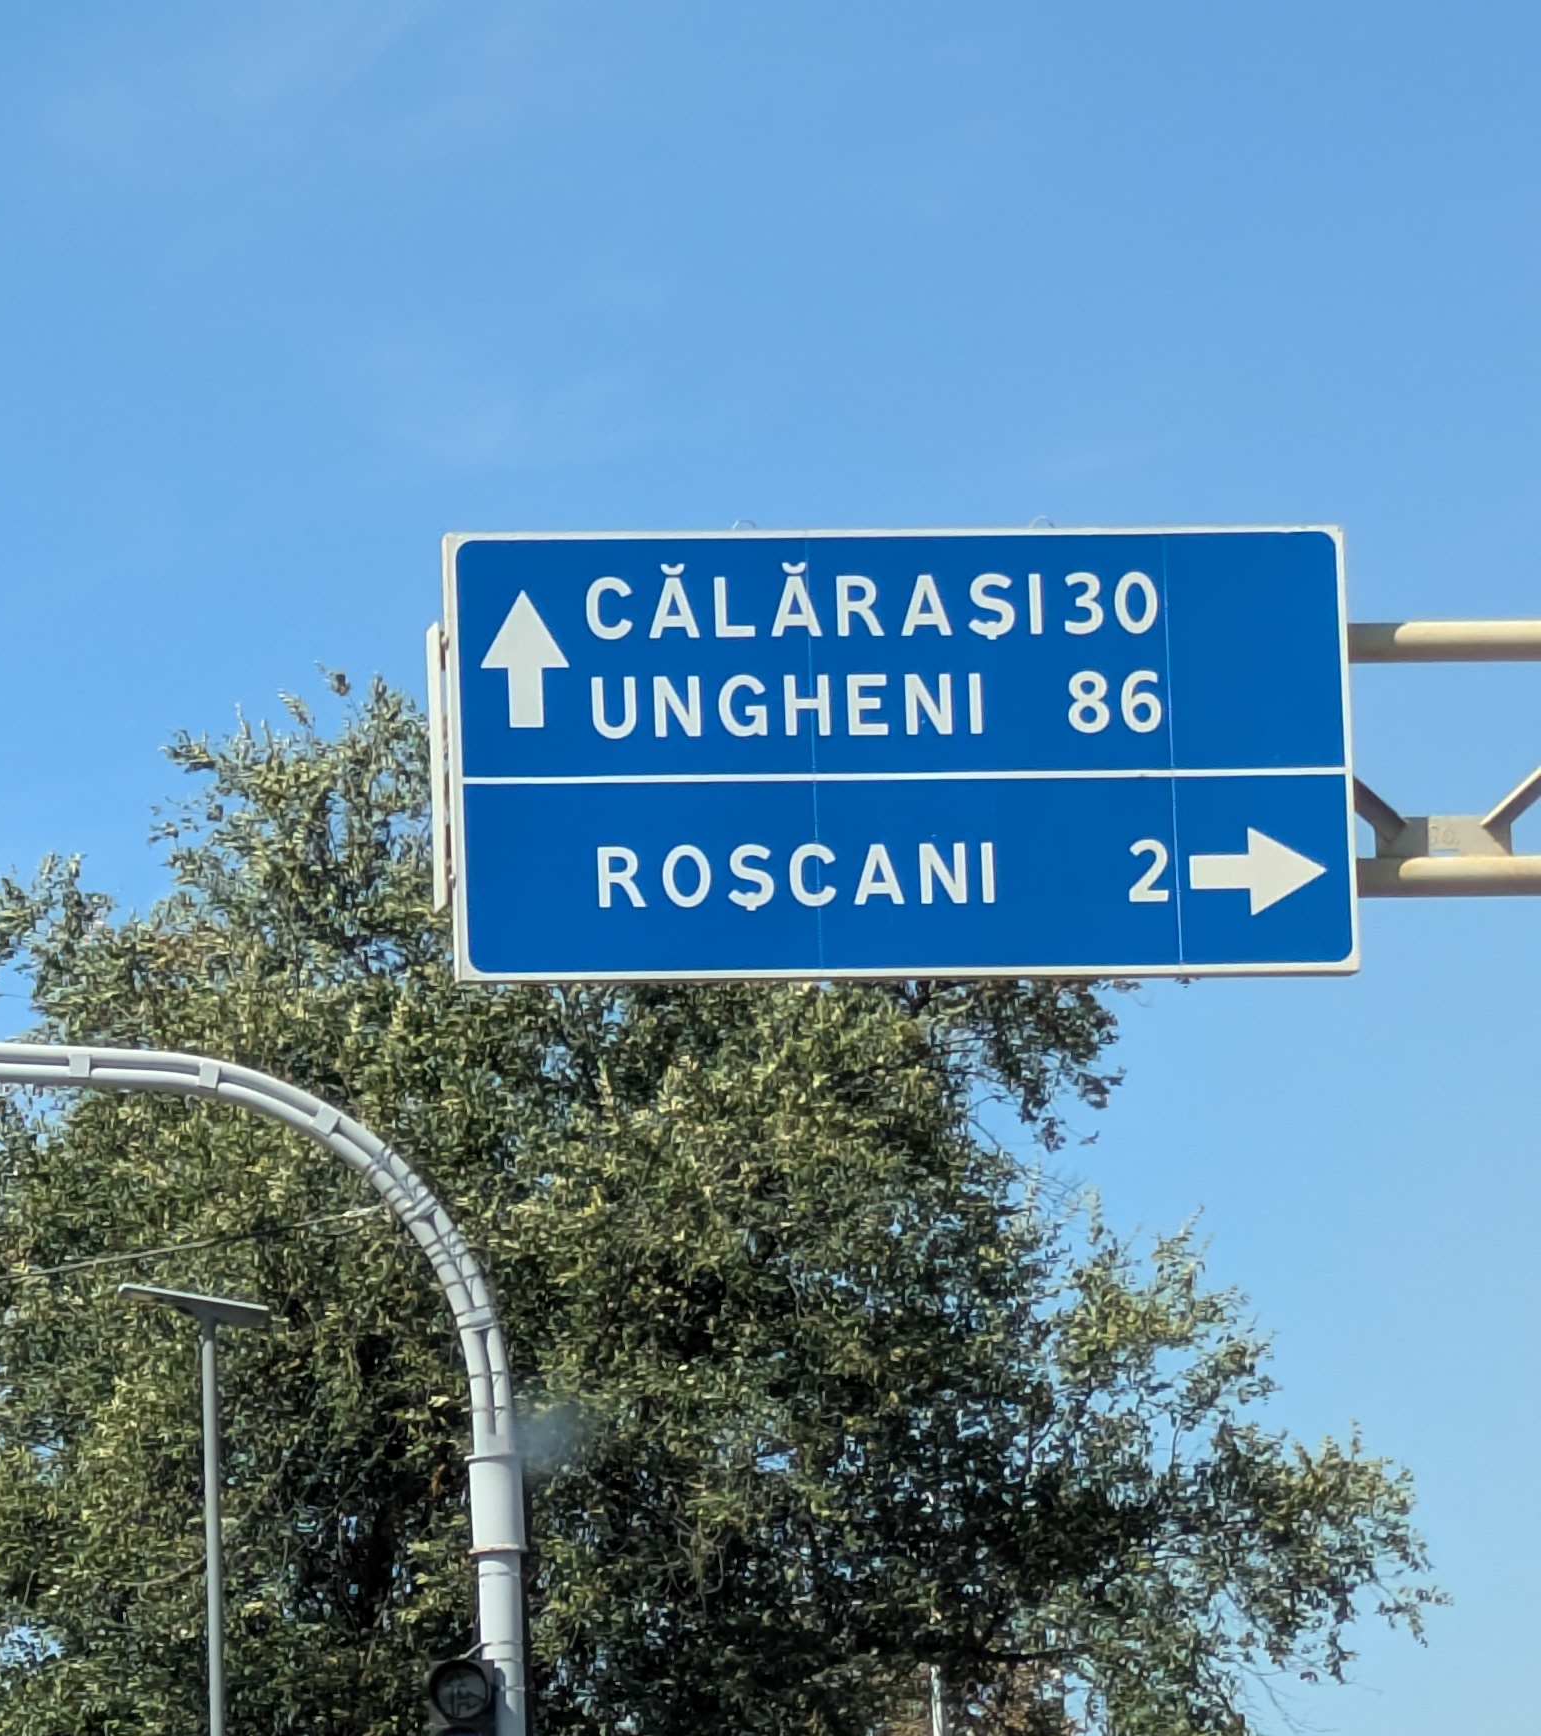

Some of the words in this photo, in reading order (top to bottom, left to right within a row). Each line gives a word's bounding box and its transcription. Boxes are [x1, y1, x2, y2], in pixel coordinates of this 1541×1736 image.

[584, 561, 1044, 641] CĂLĂRAȘI
[1063, 570, 1159, 636] 30
[589, 671, 984, 741] UNGHENI
[1067, 669, 1163, 735] 86
[596, 840, 996, 913] ROȘCANI
[1127, 837, 1171, 904] 2
